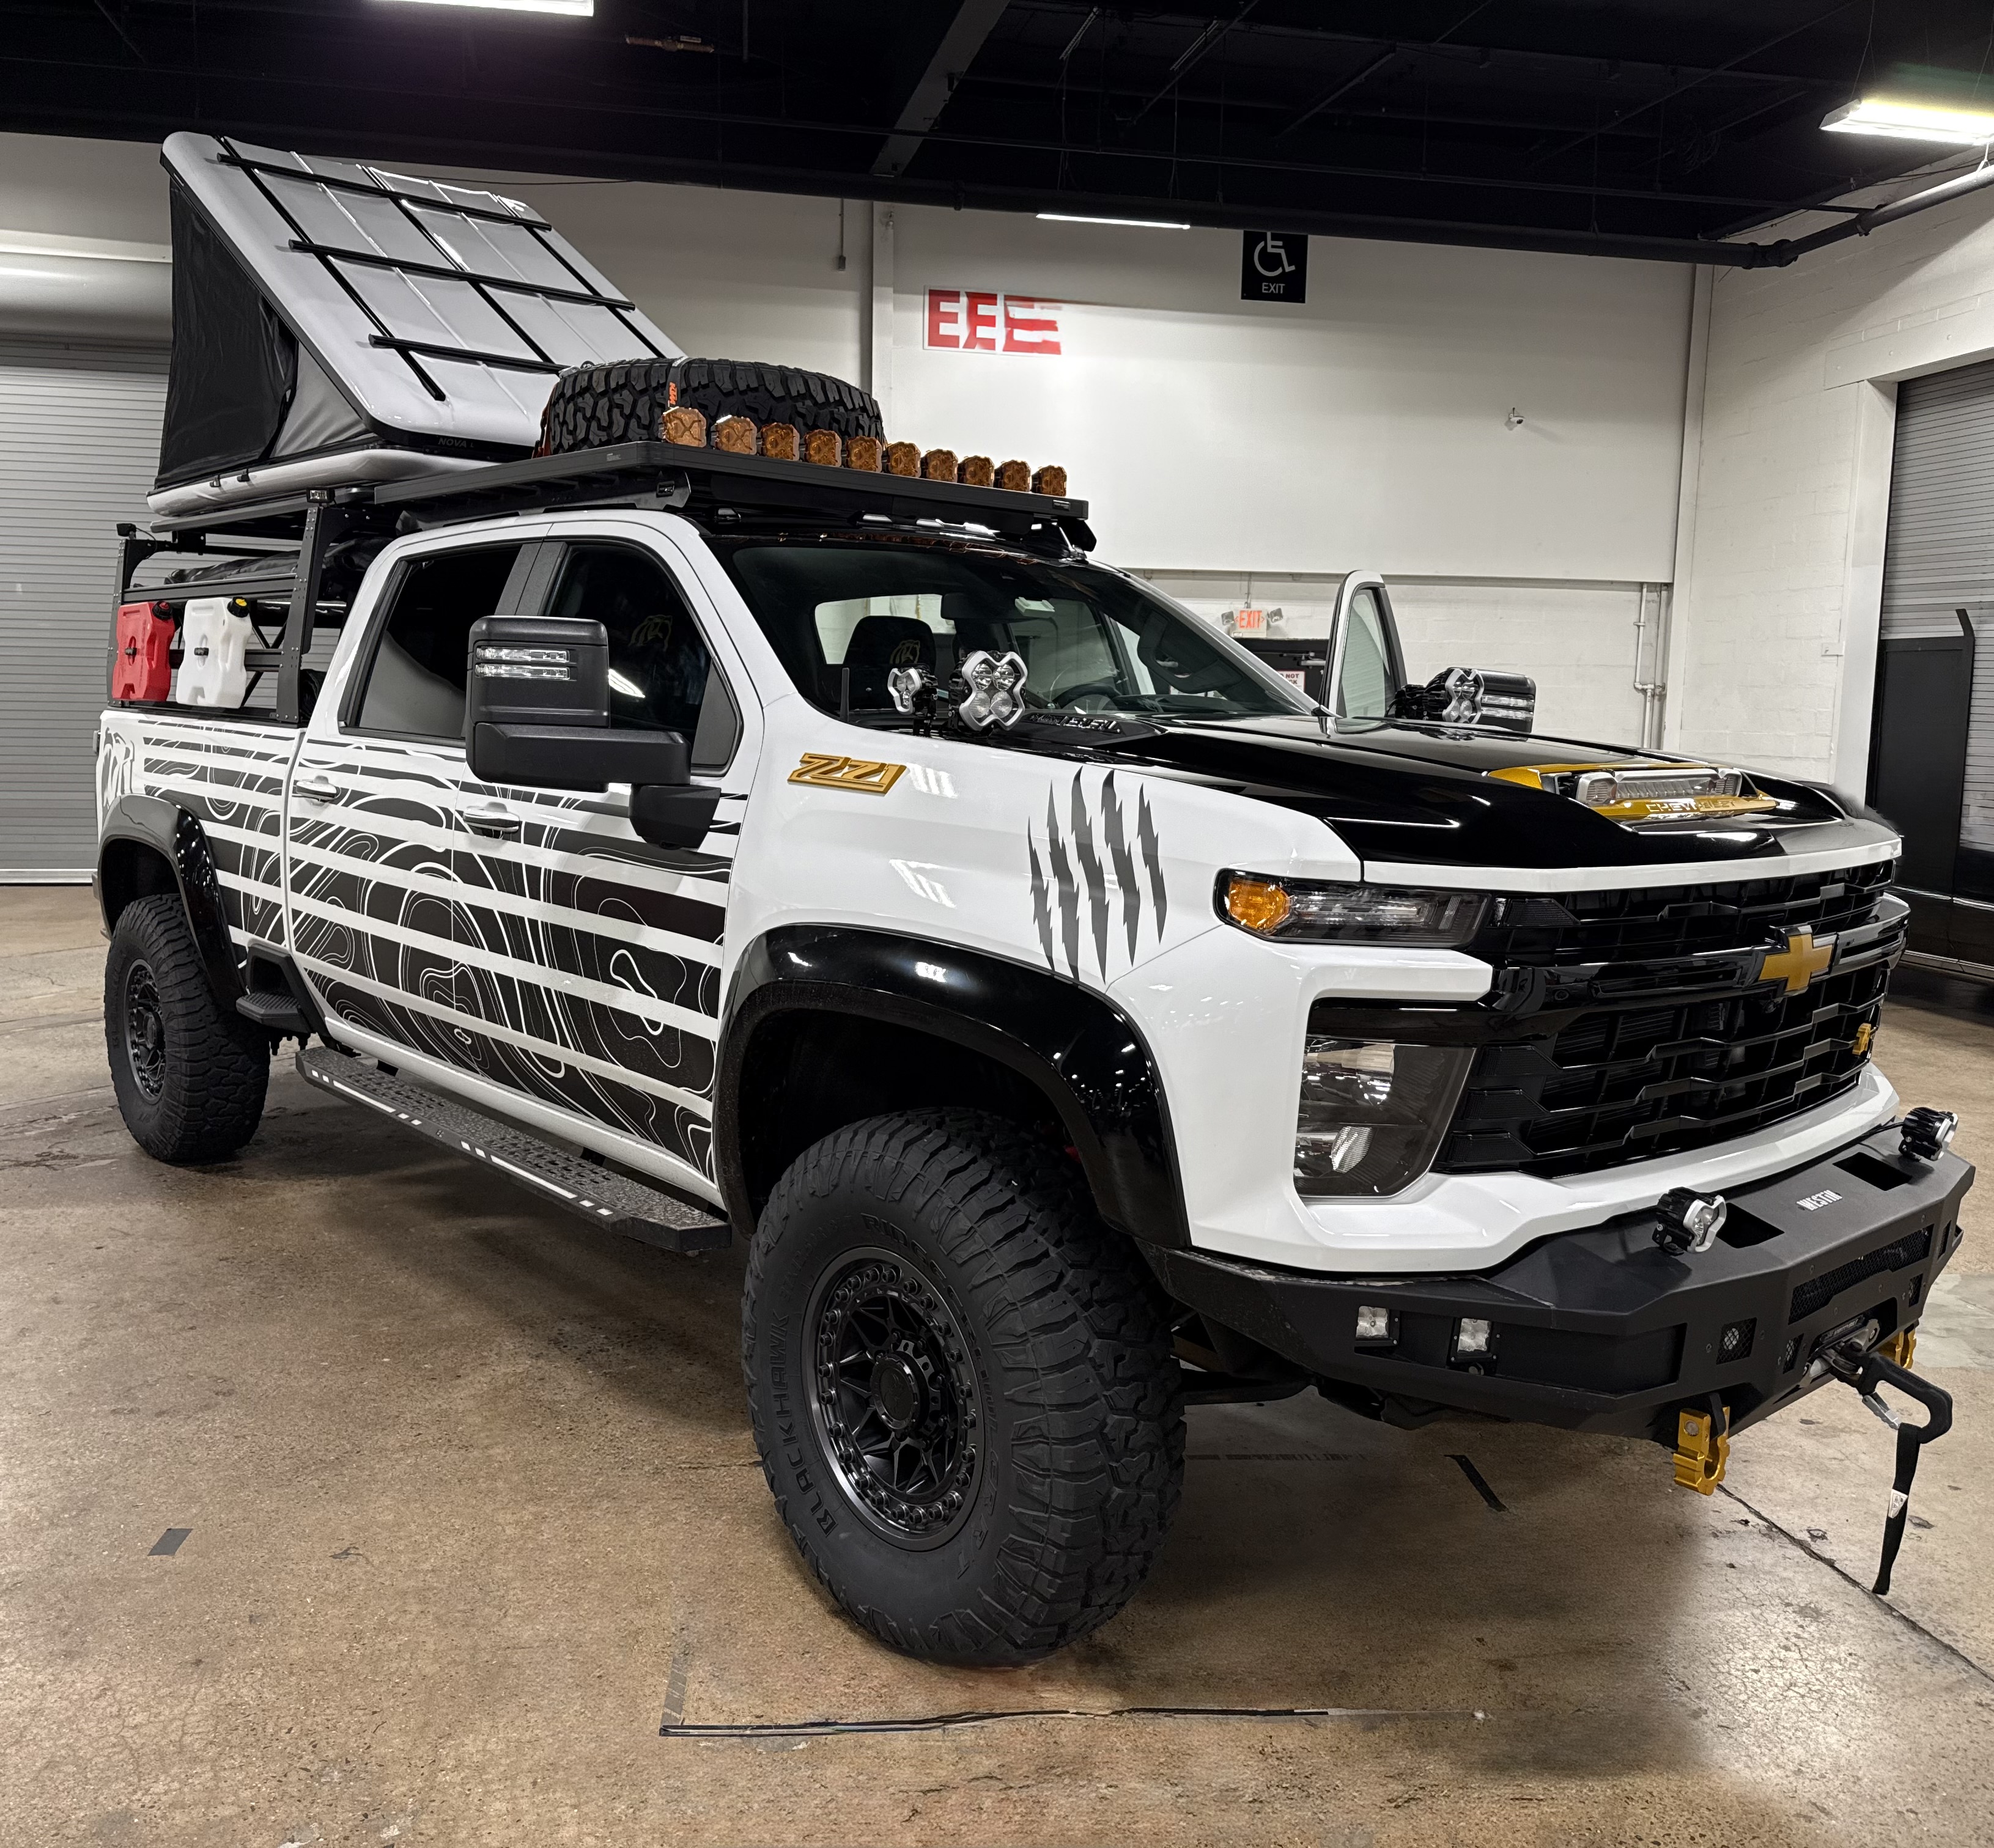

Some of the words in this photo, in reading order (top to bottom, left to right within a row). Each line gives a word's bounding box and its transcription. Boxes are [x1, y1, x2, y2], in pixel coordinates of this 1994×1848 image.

[1261, 282, 1285, 293] EXIT
[438, 437, 467, 447] NOVA
[1239, 610, 1262, 629] EXIT
[770, 1310, 838, 1537] BLACKHAWK
